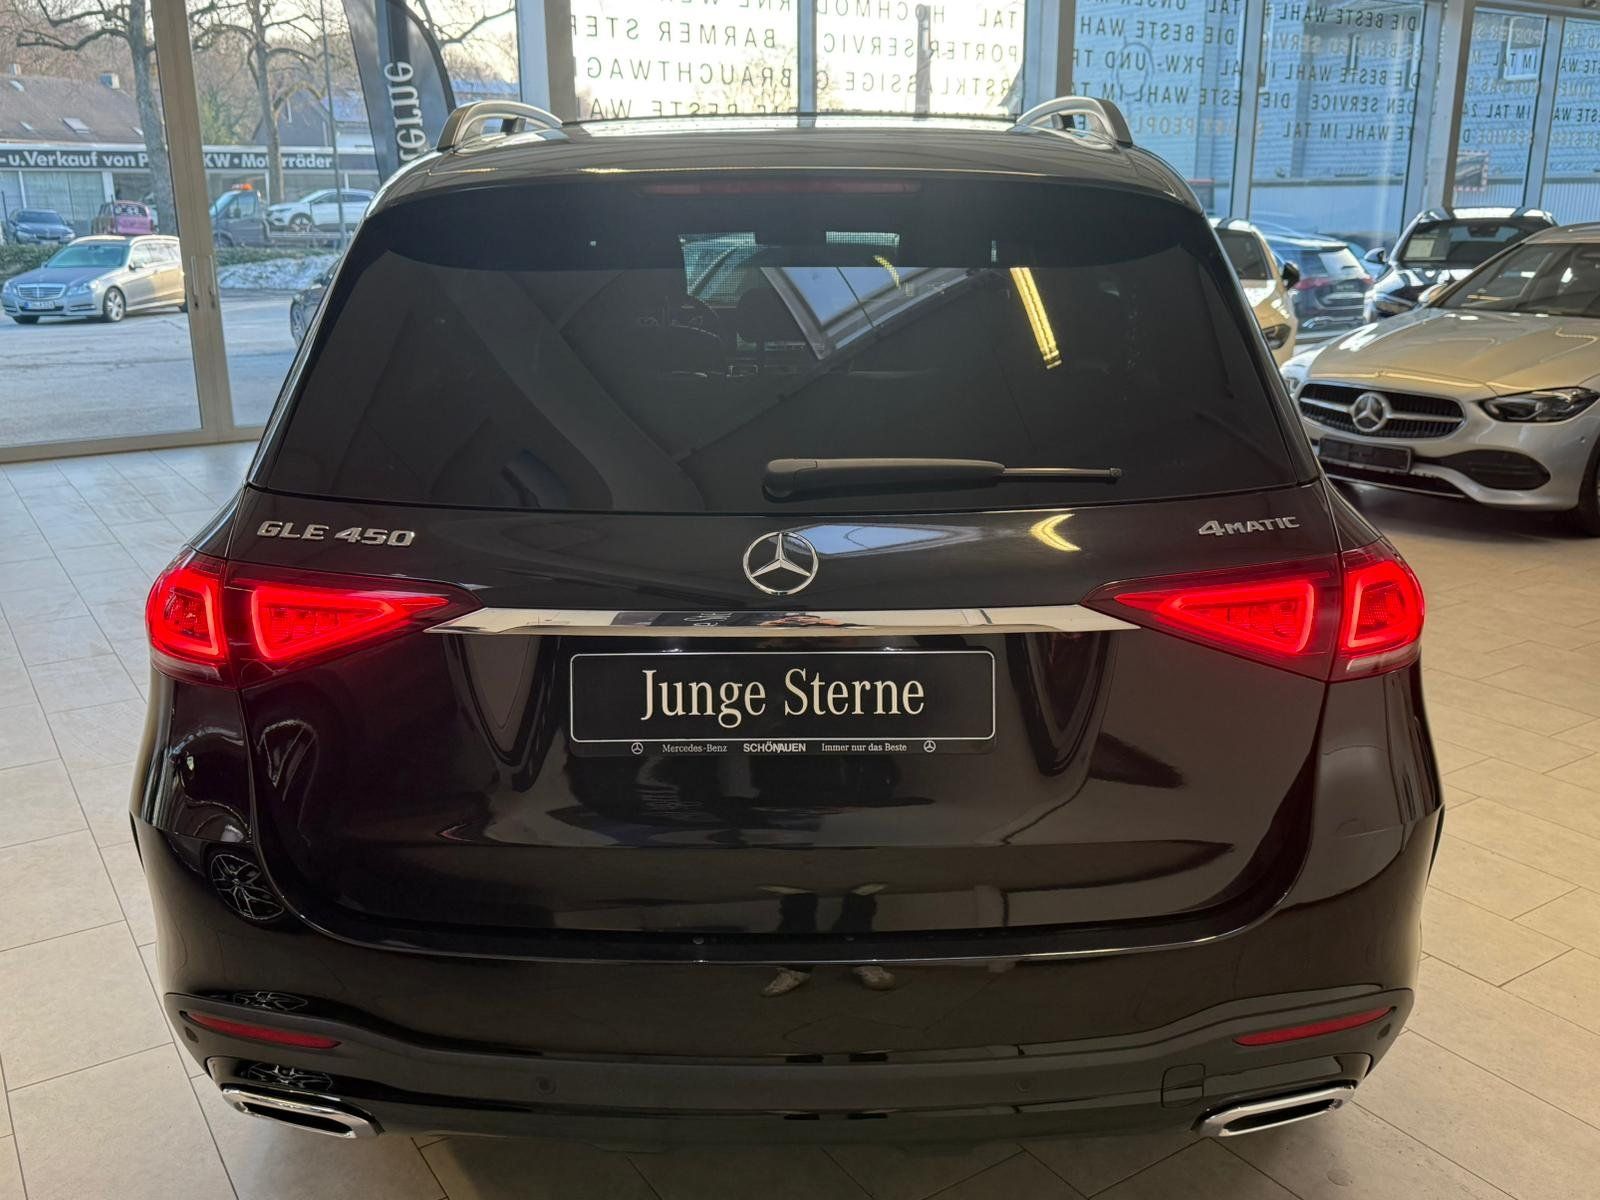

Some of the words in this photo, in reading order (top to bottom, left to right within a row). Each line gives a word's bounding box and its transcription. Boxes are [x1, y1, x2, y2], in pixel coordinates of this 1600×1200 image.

[102, 154, 136, 167] von
[1198, 516, 1300, 536] 4MATIC
[256, 520, 330, 541] GLE
[334, 527, 416, 547] 450
[640, 669, 767, 729] Junge
[784, 668, 925, 716] Sterne
[662, 743, 728, 753] Mercedes-Benz
[742, 741, 806, 753] SCHÖNAUEN
[821, 743, 850, 752] Immer
[851, 744, 866, 752] nur
[868, 743, 883, 752] das
[884, 742, 908, 752] Beste
